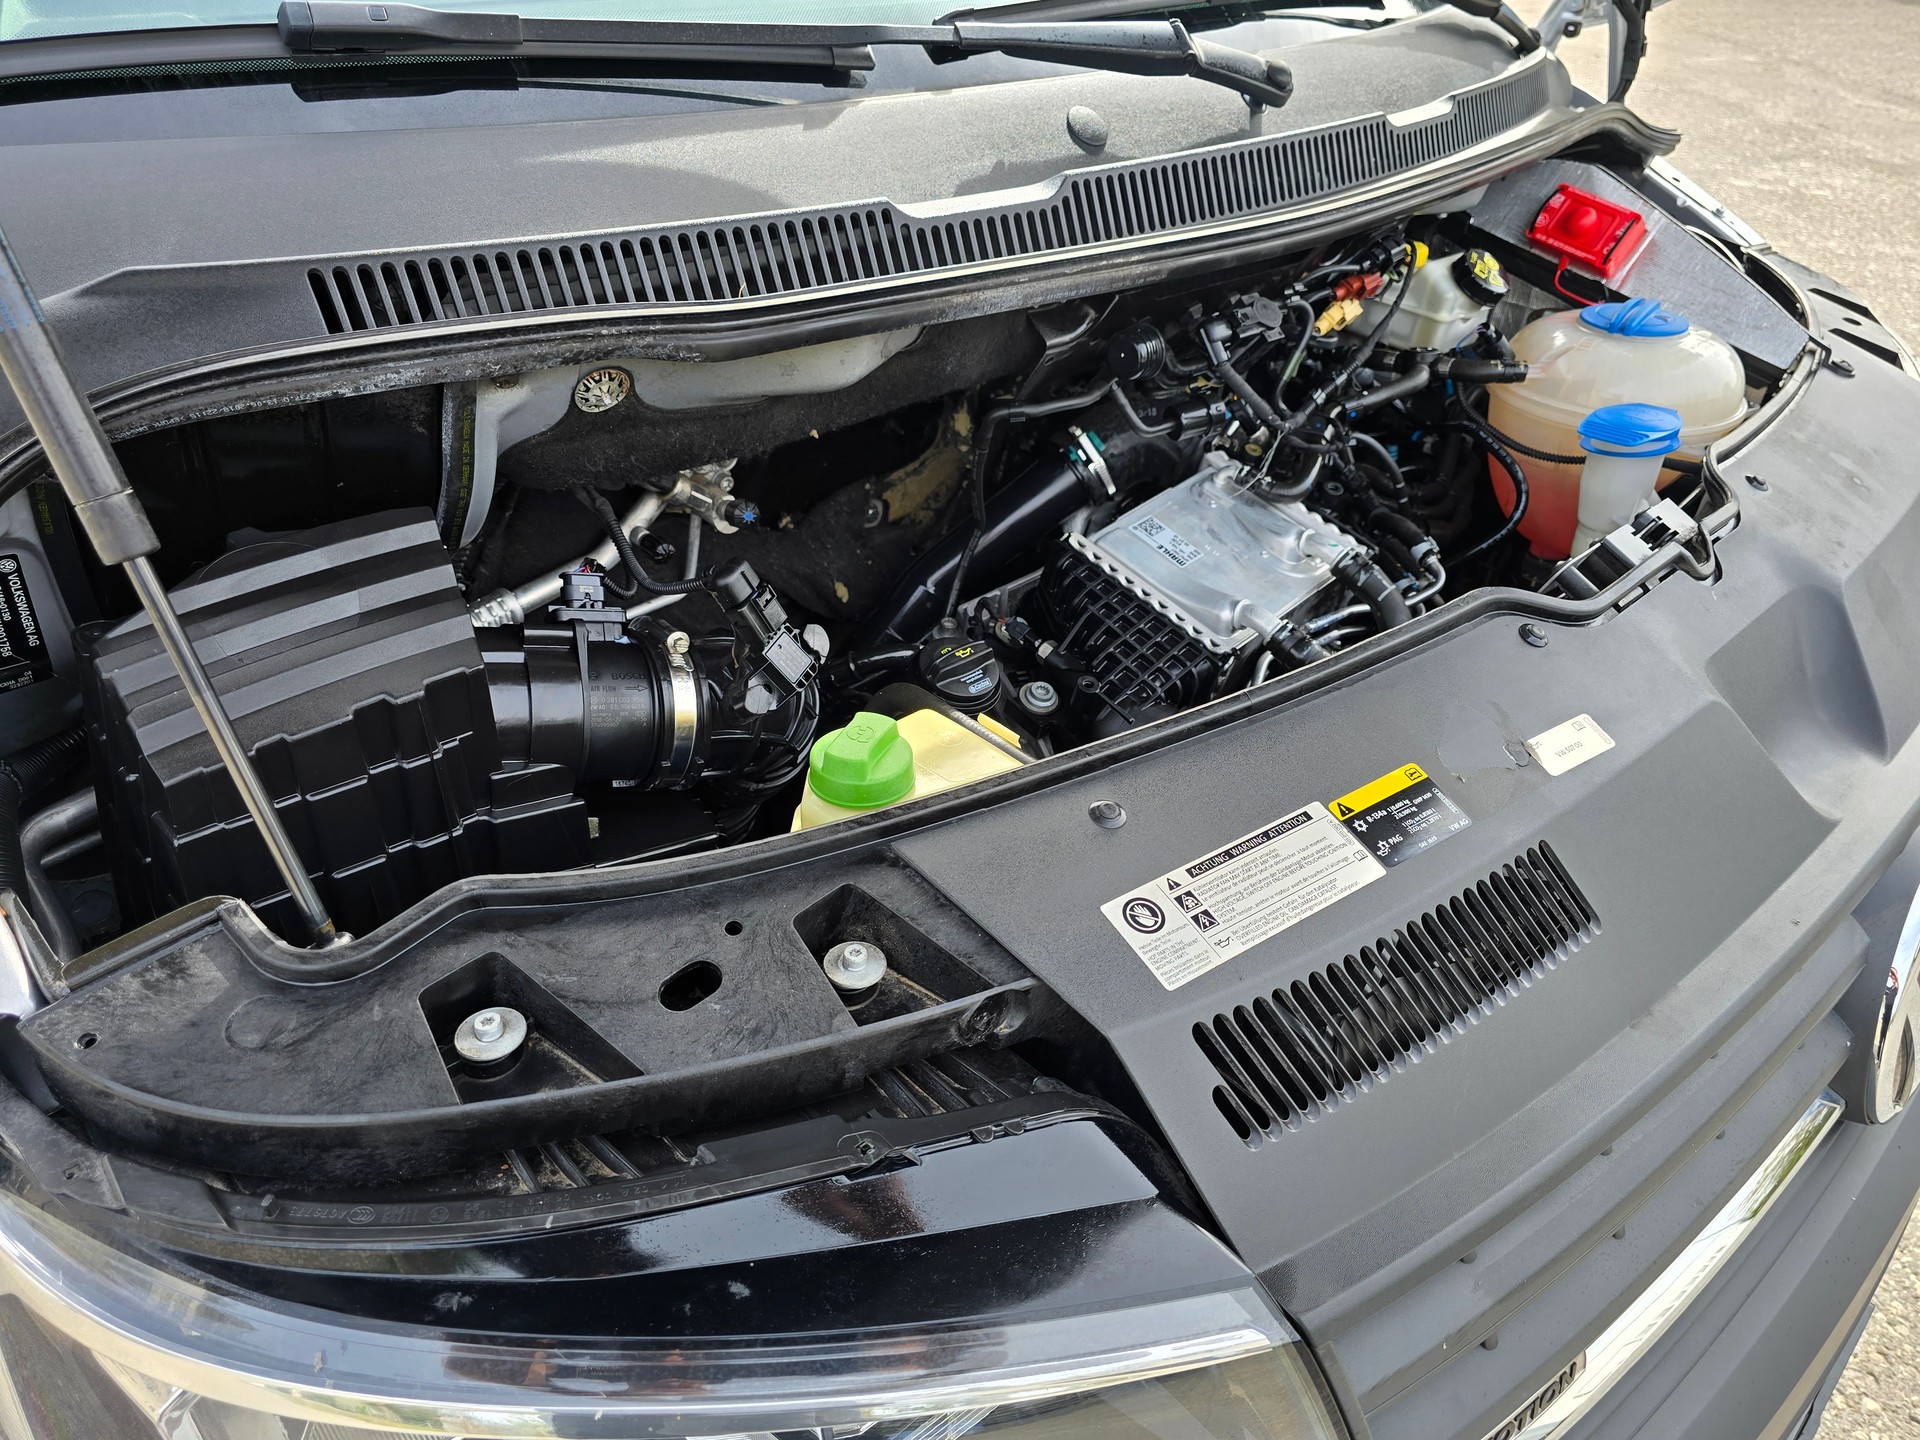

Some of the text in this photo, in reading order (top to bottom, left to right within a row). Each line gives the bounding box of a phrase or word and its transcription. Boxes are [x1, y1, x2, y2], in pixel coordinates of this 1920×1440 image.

[1156, 544, 1187, 567] MAHLE
[7, 572, 40, 647] VOLKSWAGEN AG
[611, 672, 647, 680] BOSCH
[1365, 810, 1388, 823] R-134a
[1448, 818, 1469, 831] VW AG
[1191, 853, 1229, 876] ACHTUNG
[1229, 834, 1267, 856] WARNING
[1268, 814, 1307, 838] ATTENTION
[1388, 834, 1404, 845] PAG
[1488, 1361, 1577, 1440] OTION
